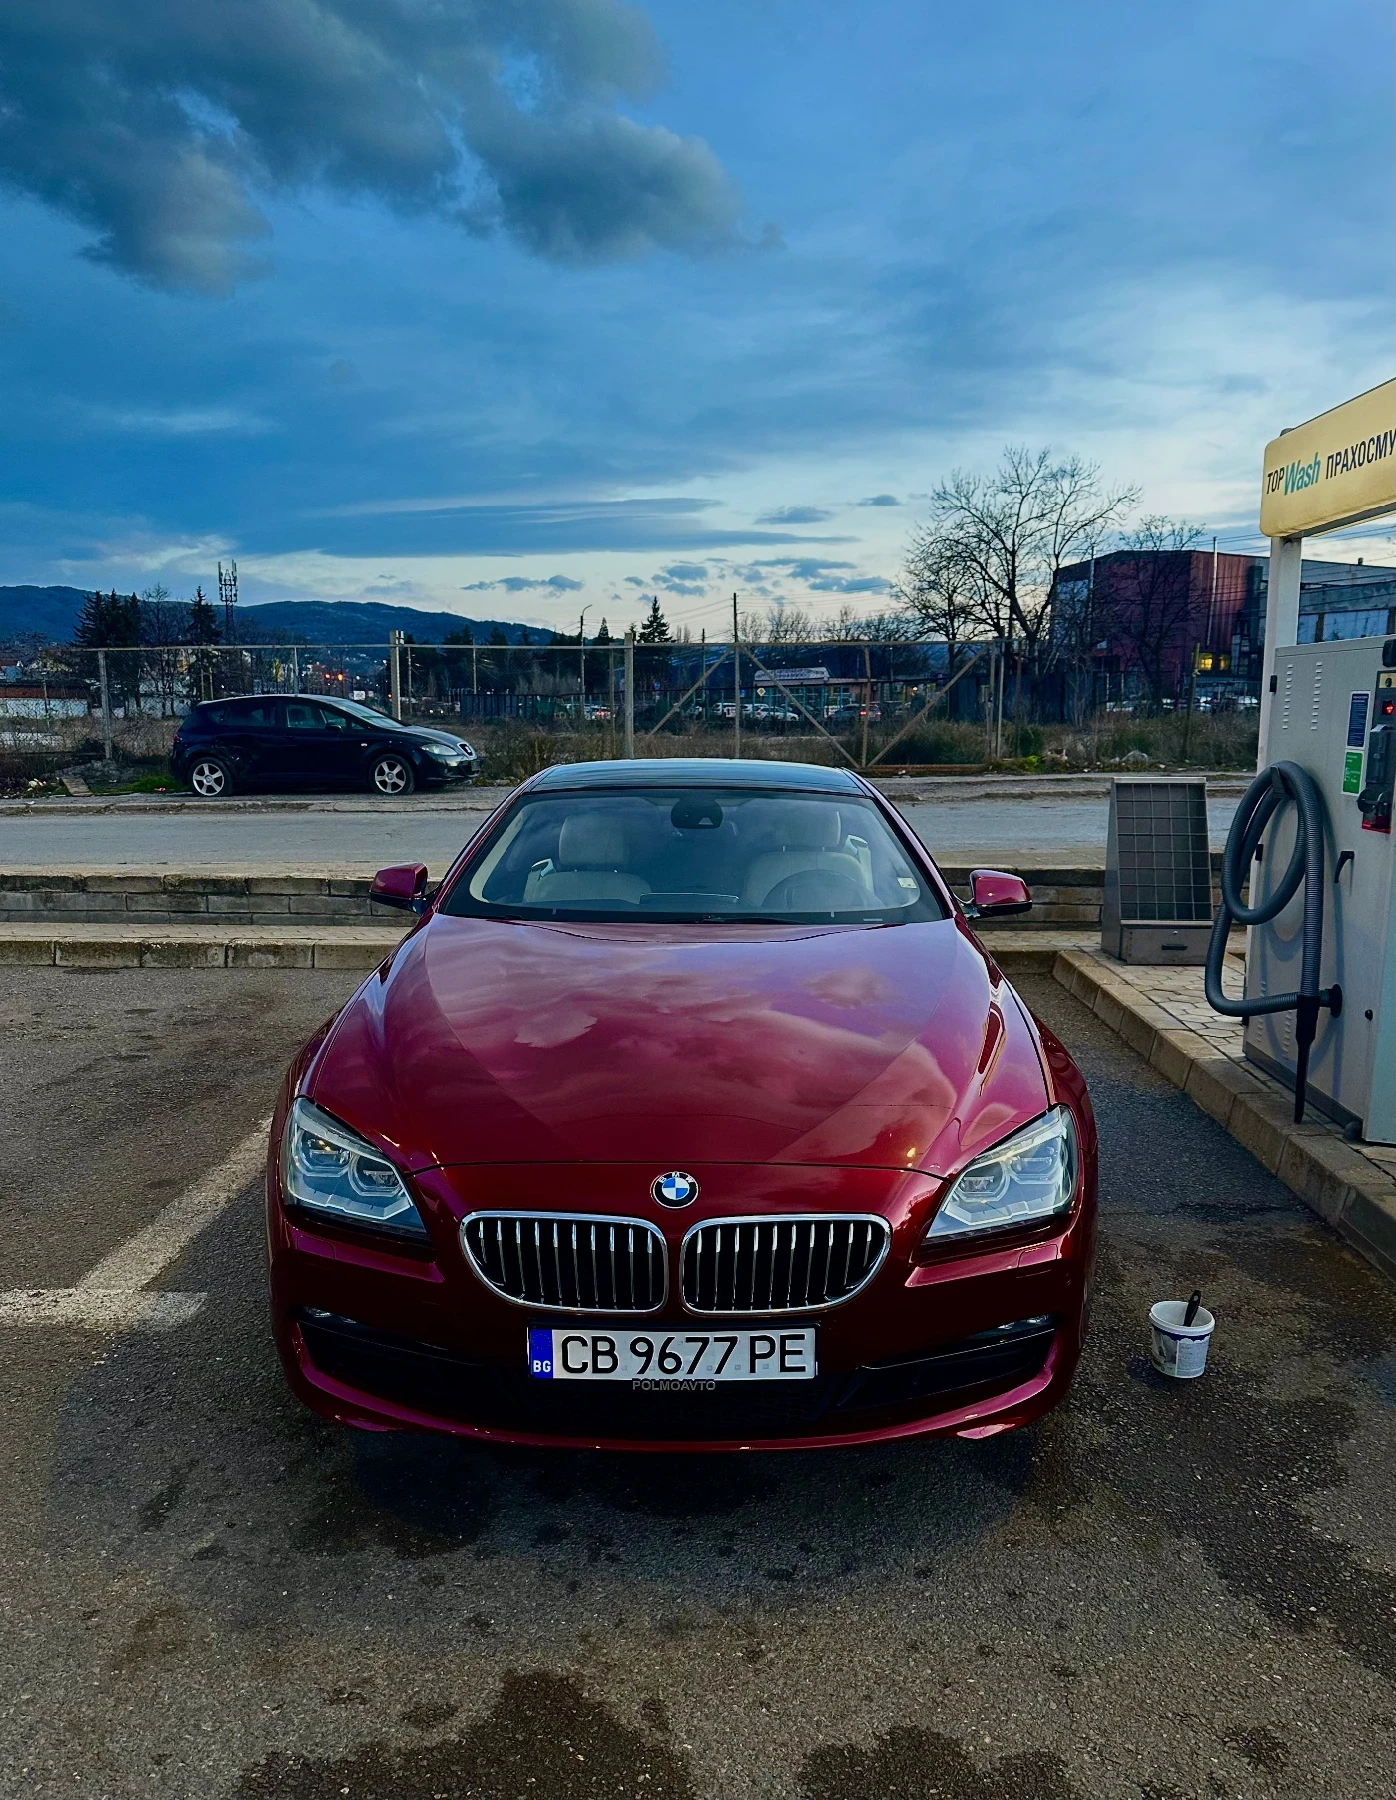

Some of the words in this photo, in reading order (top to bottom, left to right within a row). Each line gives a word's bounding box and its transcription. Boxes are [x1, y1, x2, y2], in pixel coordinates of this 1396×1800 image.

[561, 1335, 619, 1374] CB
[629, 1336, 739, 1375] 9677
[749, 1333, 807, 1374] PE
[533, 1360, 551, 1373] BG
[632, 1380, 716, 1391] POLMOAVTO
